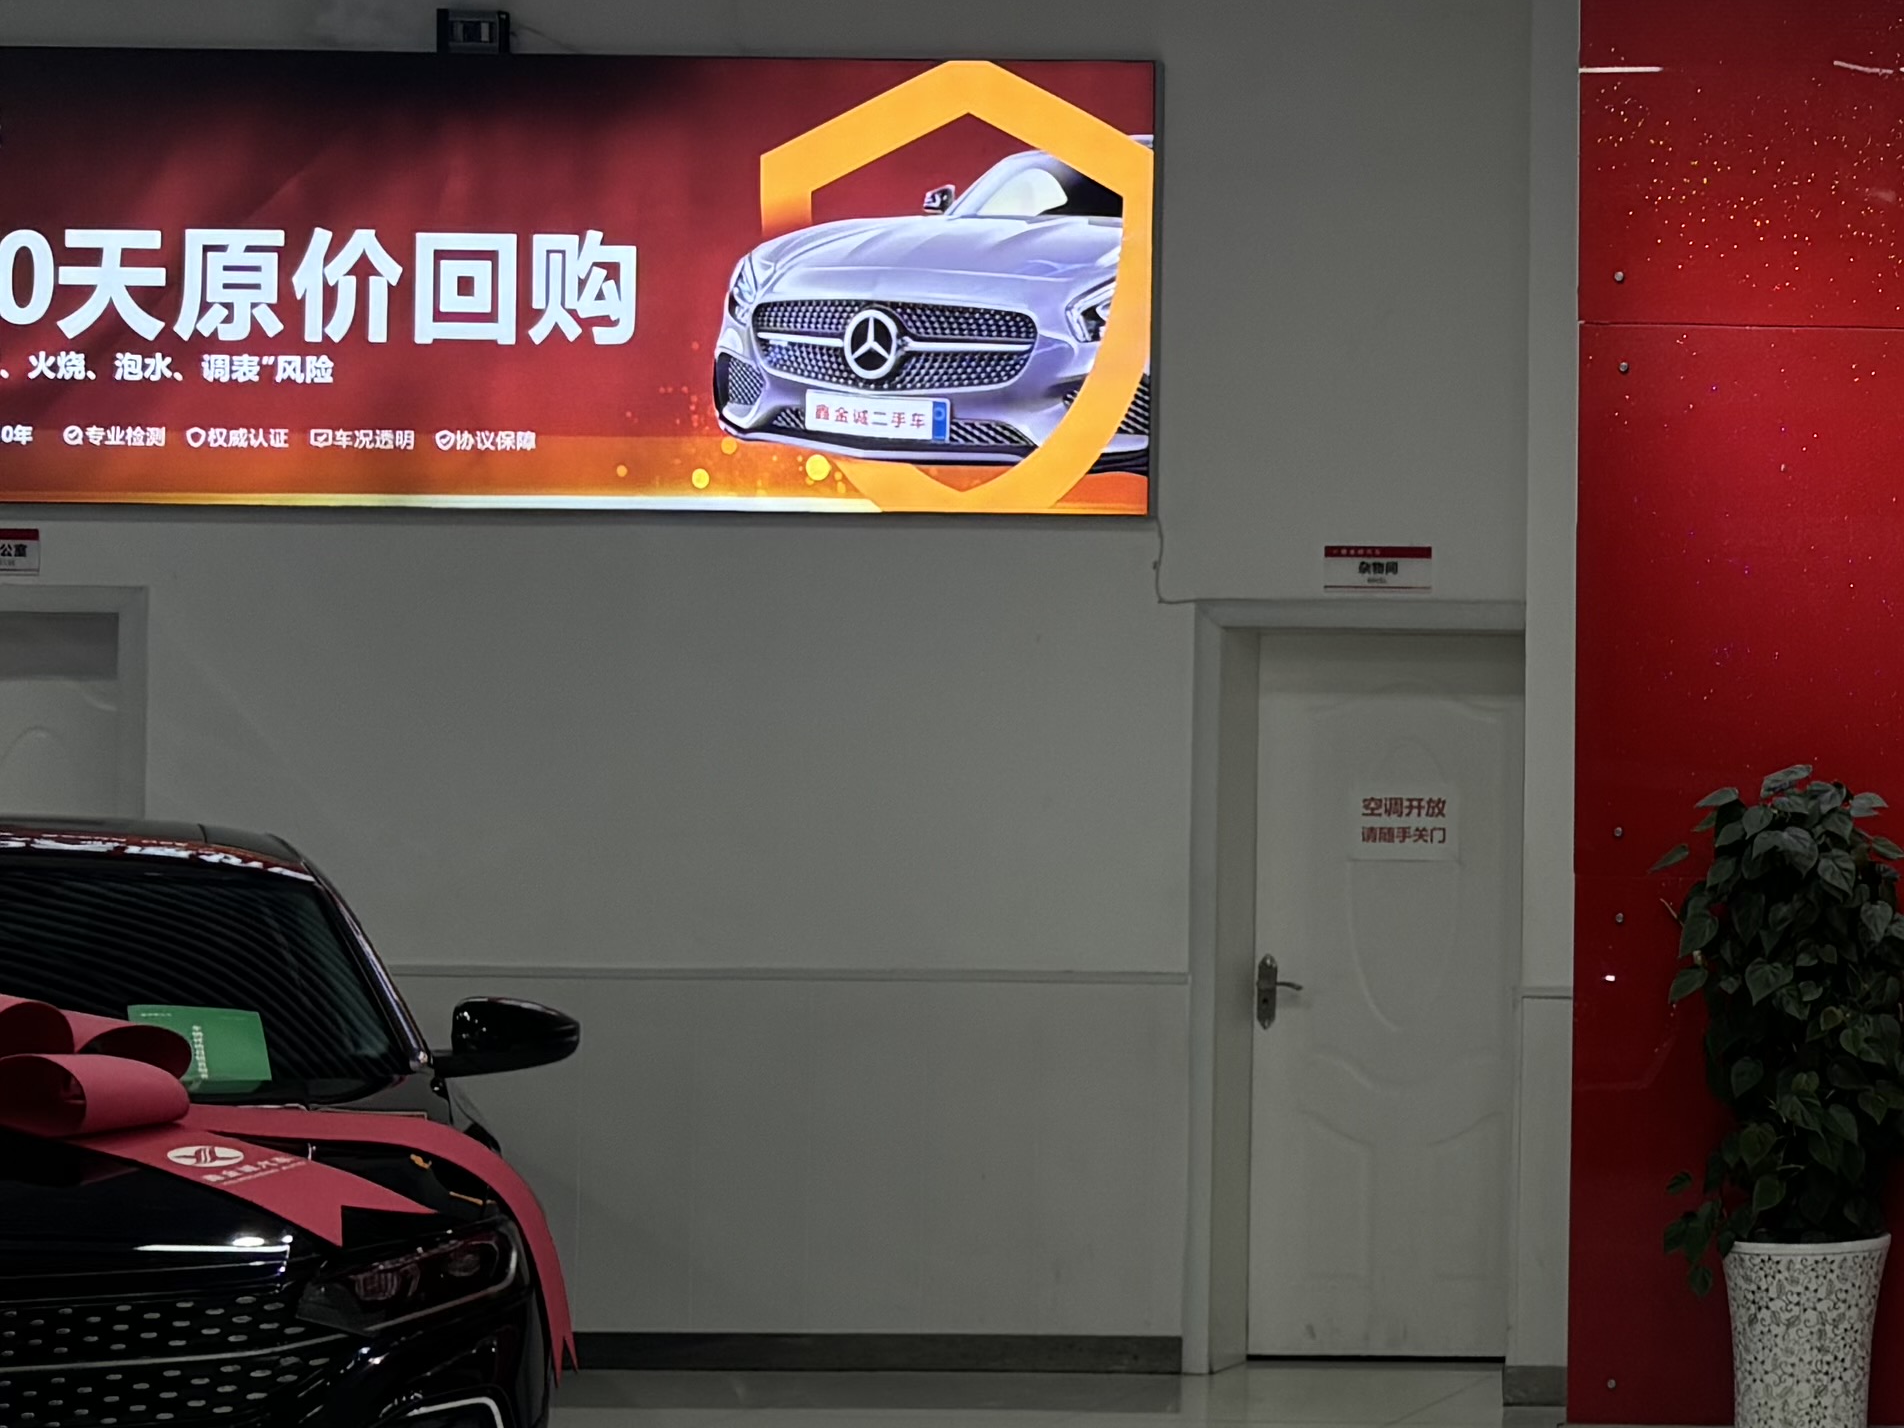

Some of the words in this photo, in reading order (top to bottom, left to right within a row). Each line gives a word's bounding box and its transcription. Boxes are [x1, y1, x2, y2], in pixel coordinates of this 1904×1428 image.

[0, 227, 637, 345] 0天原价回购
[815, 404, 926, 429] 鑫金诚二手车
[85, 425, 166, 446] 专业检测
[208, 427, 289, 448] 权威认证
[334, 429, 415, 450] 车况透明
[456, 431, 536, 452] 协议保障
[1361, 797, 1446, 818] 空调开放
[1361, 826, 1446, 844] 请随手关门
